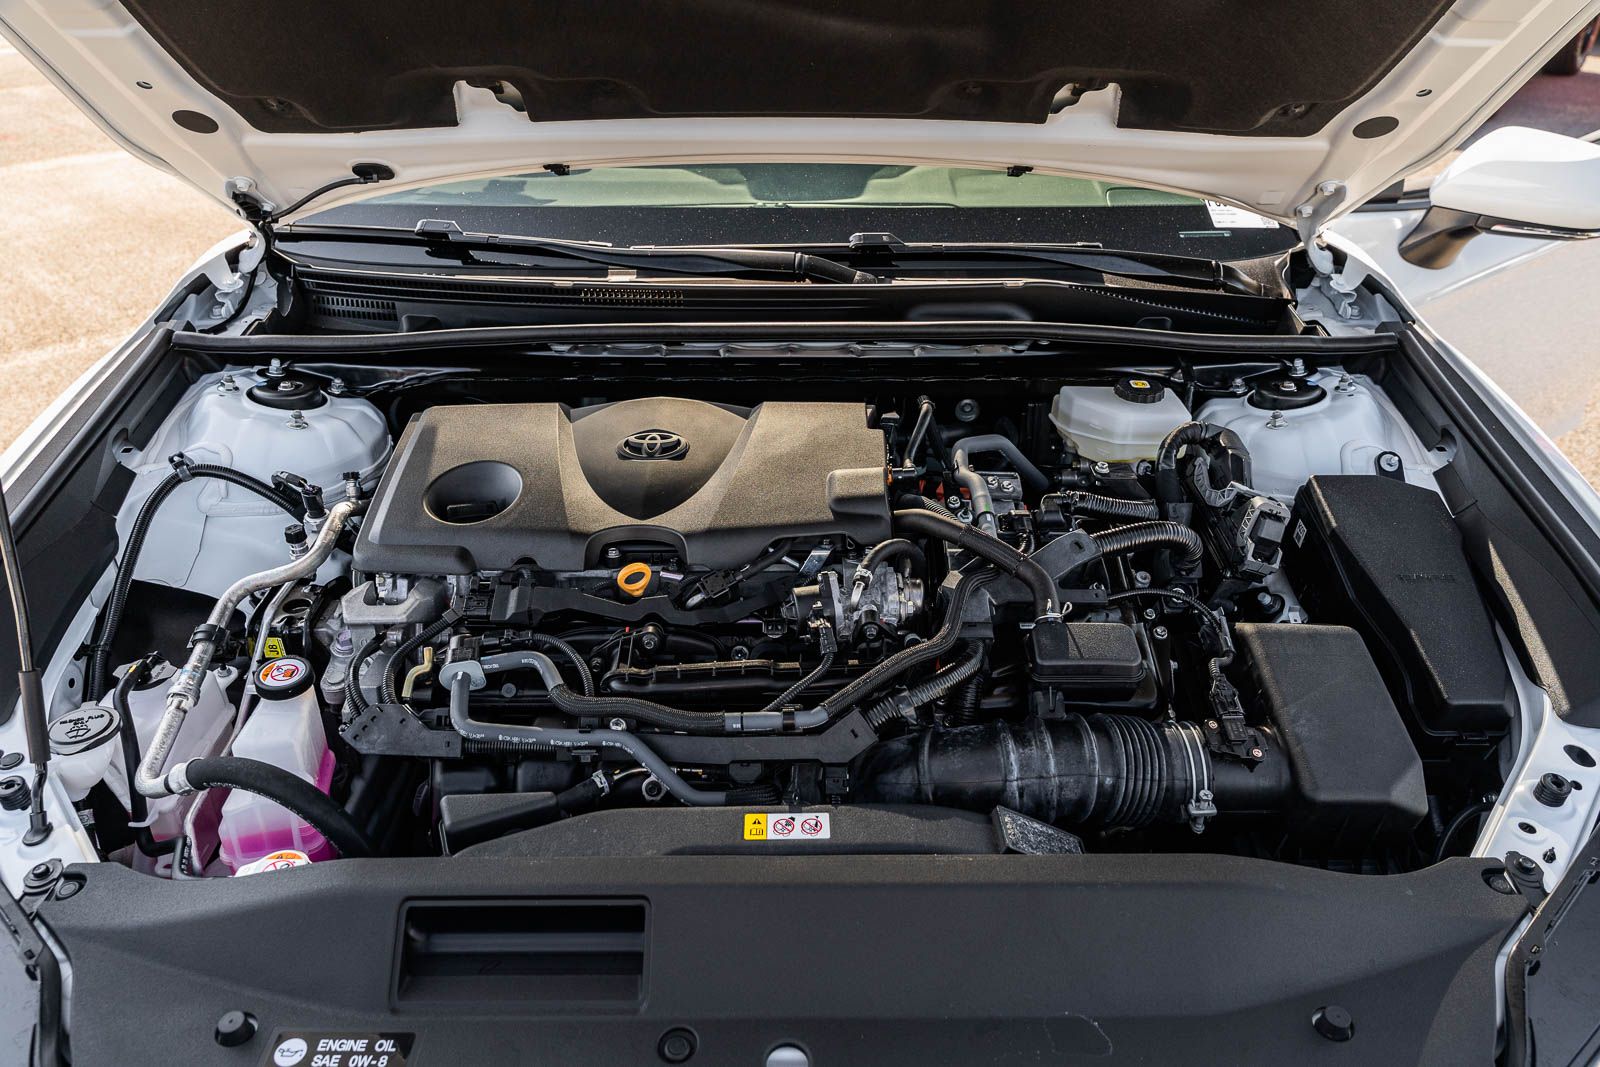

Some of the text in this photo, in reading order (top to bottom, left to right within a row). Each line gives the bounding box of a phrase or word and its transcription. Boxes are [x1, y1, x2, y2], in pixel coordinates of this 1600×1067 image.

[267, 644, 280, 655] J8
[317, 1039, 397, 1052] ENGINE OIL
[310, 1055, 389, 1067] SAE 0W-8
